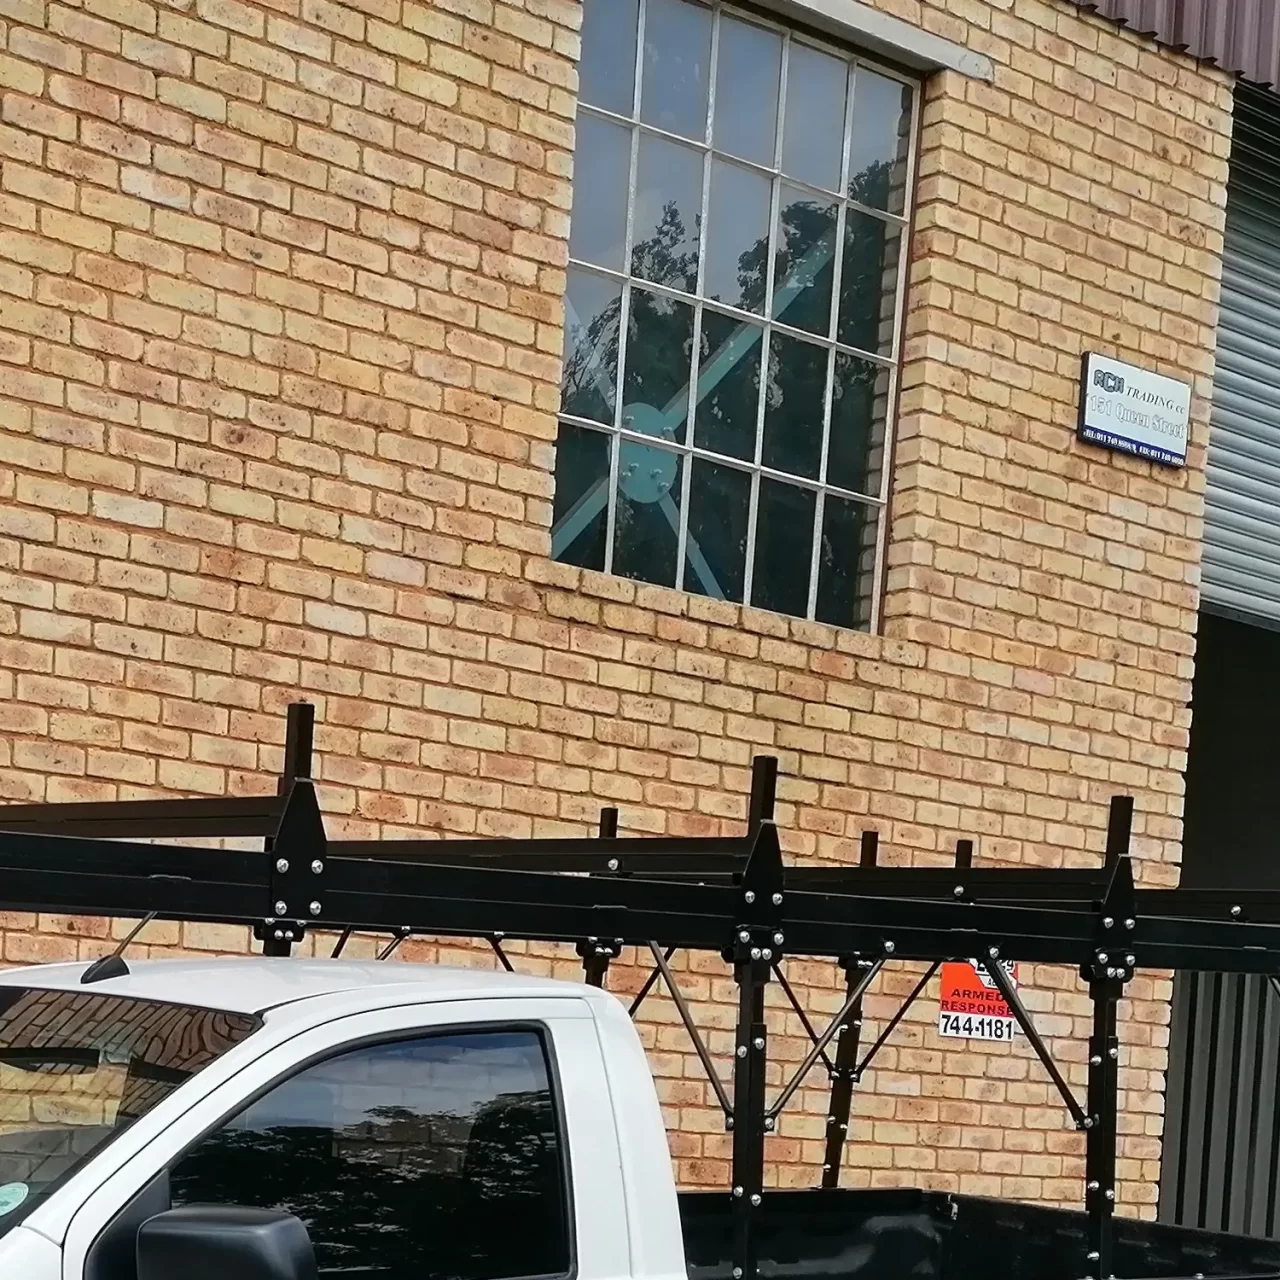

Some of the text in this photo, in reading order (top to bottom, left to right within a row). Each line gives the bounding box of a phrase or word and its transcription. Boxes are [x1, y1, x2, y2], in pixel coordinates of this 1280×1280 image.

[1126, 386, 1174, 410] TRADING
[1116, 403, 1150, 429] Queen
[1152, 414, 1186, 439] Street
[951, 988, 1004, 1001] ARMED
[941, 1000, 1014, 1016] RESPONSE
